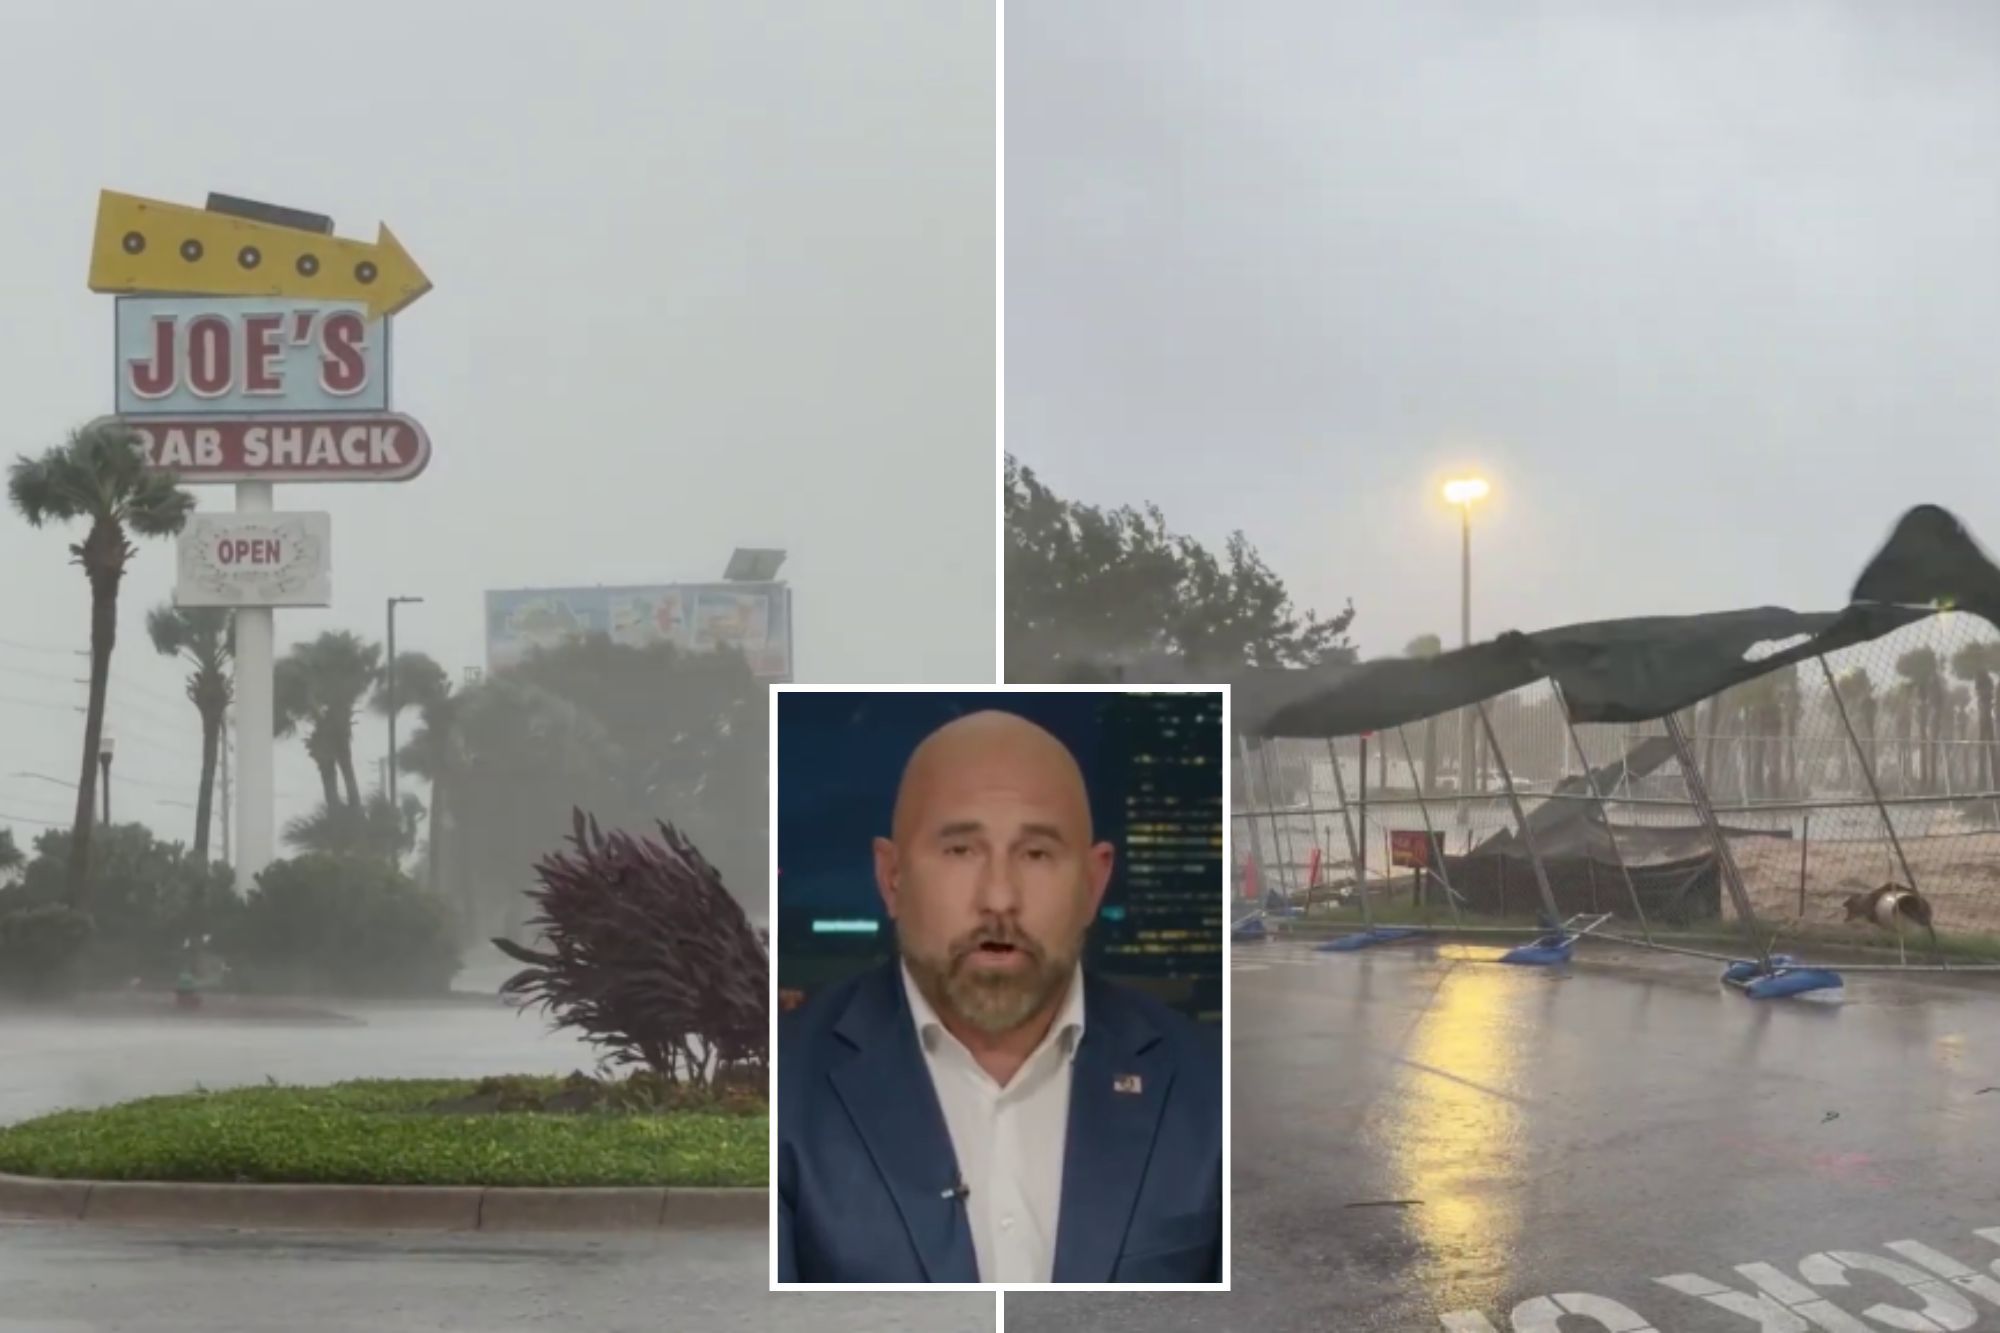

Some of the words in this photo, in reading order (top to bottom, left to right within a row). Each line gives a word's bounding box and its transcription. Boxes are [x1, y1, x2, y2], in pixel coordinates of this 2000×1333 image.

[128, 309, 369, 398] JOE'S
[124, 427, 223, 466] RAB
[243, 426, 404, 466] SHACK
[218, 539, 281, 565] OPEN
